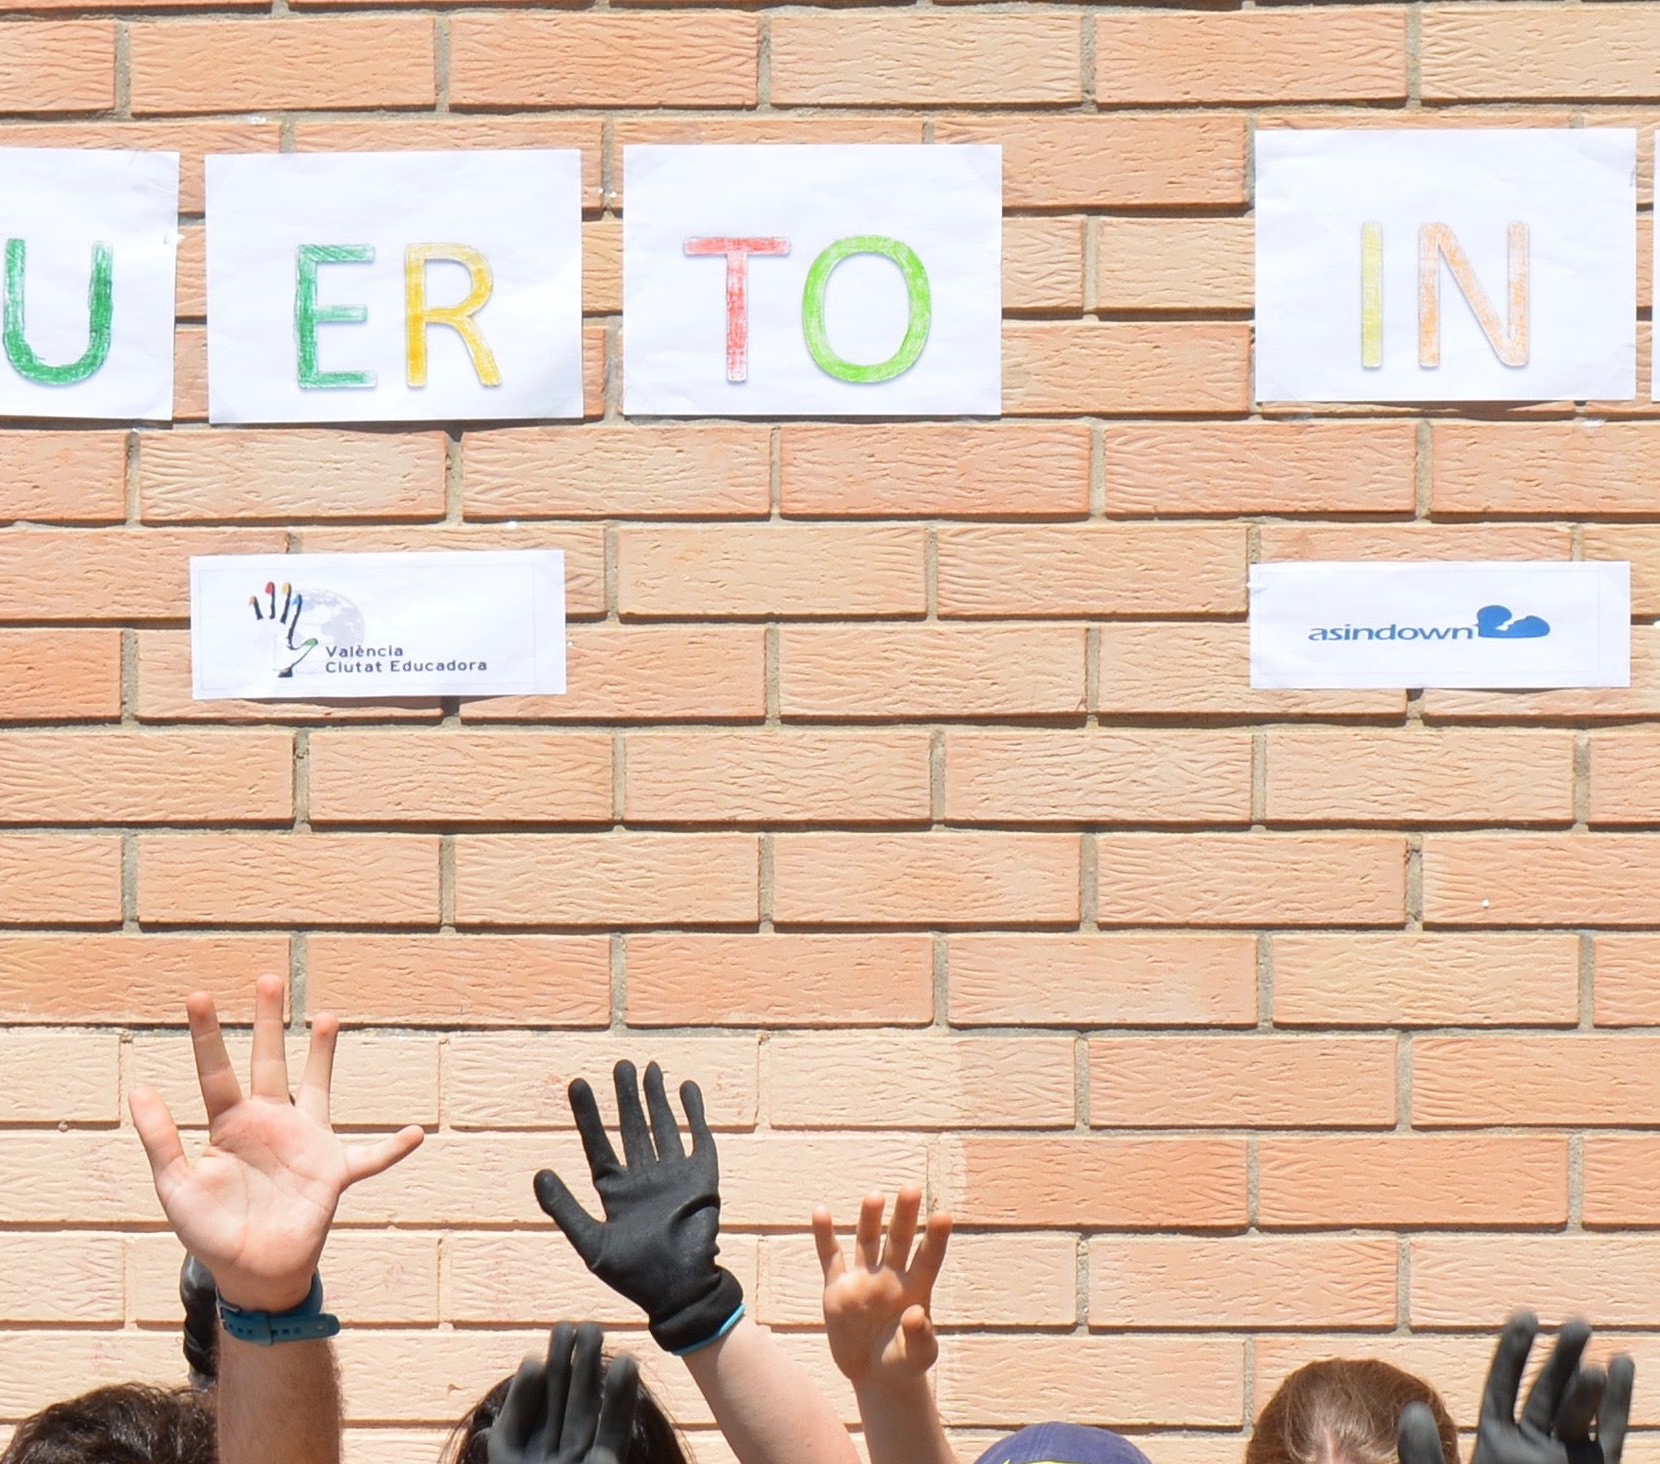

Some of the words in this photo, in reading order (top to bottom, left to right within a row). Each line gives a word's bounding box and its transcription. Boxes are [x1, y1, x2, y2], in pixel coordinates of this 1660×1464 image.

[1307, 623, 1473, 641] asindown
[324, 644, 405, 658] València
[324, 659, 383, 674] Ciutat
[390, 658, 488, 673] Educadora
